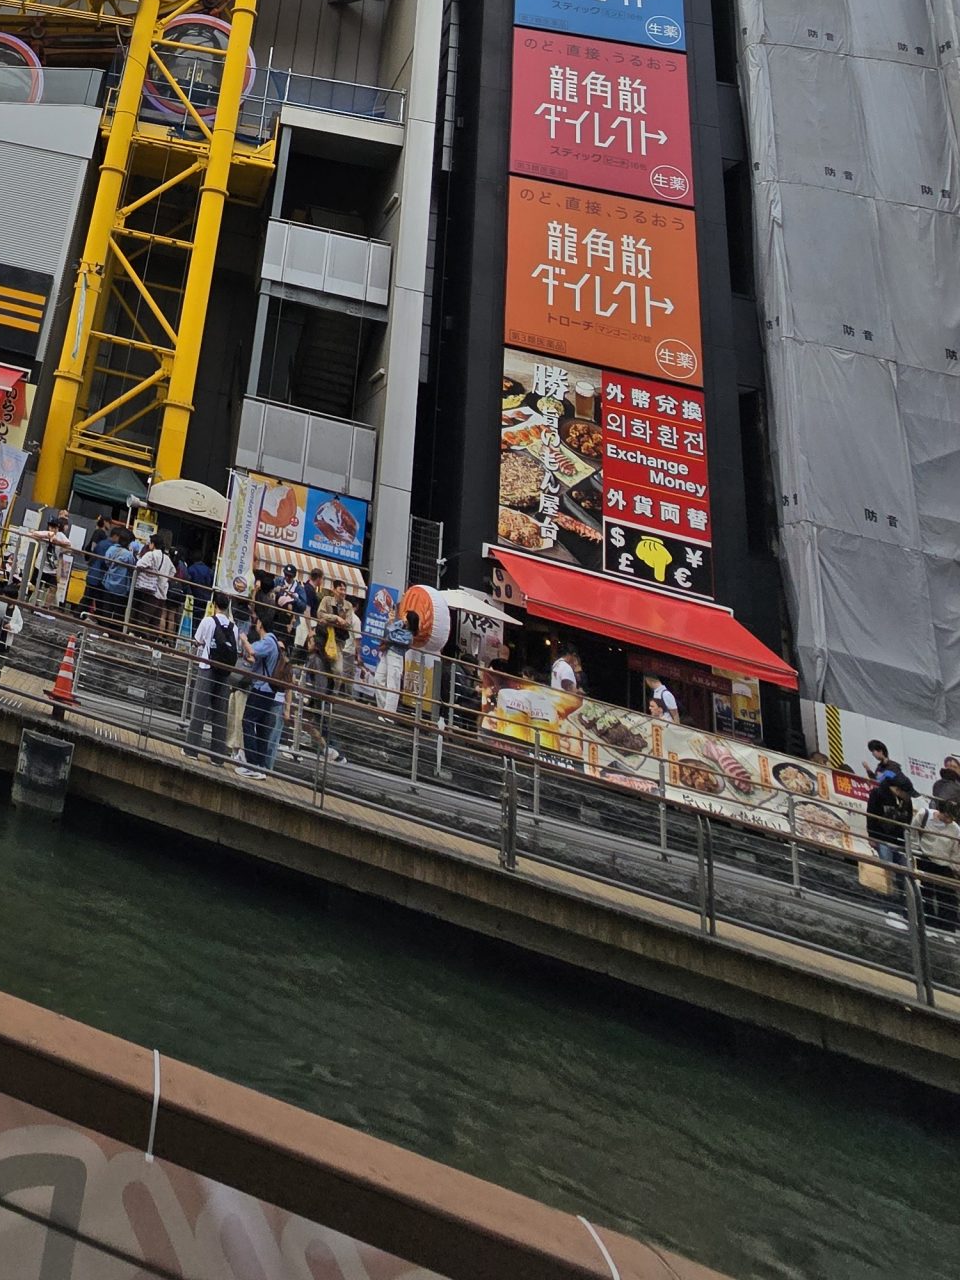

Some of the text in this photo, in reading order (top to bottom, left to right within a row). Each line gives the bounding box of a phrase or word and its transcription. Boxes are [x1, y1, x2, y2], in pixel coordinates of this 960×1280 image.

[552, 0, 600, 16] スティック
[648, 22, 679, 38] 生薬
[550, 65, 647, 115] 龍角散
[550, 146, 602, 162] スティック
[653, 173, 685, 191] 生薬
[548, 220, 652, 280] 龍角散
[548, 313, 594, 331] トローチ
[597, 324, 629, 338] マンゴー
[842, 324, 874, 341] 防音
[659, 348, 694, 369] 生薬
[532, 363, 570, 401] 勝
[606, 382, 703, 422] 外幣兌換
[606, 413, 704, 455] 외화환전
[606, 444, 689, 476] Exchange
[649, 469, 707, 498] Money
[606, 488, 708, 531] 外貨両替
[864, 508, 898, 528] 防音
[243, 519, 253, 545] River
[610, 526, 626, 548] $
[237, 545, 248, 575] Cruise
[619, 552, 635, 573] £
[685, 547, 703, 569] ¥
[674, 567, 692, 588] €
